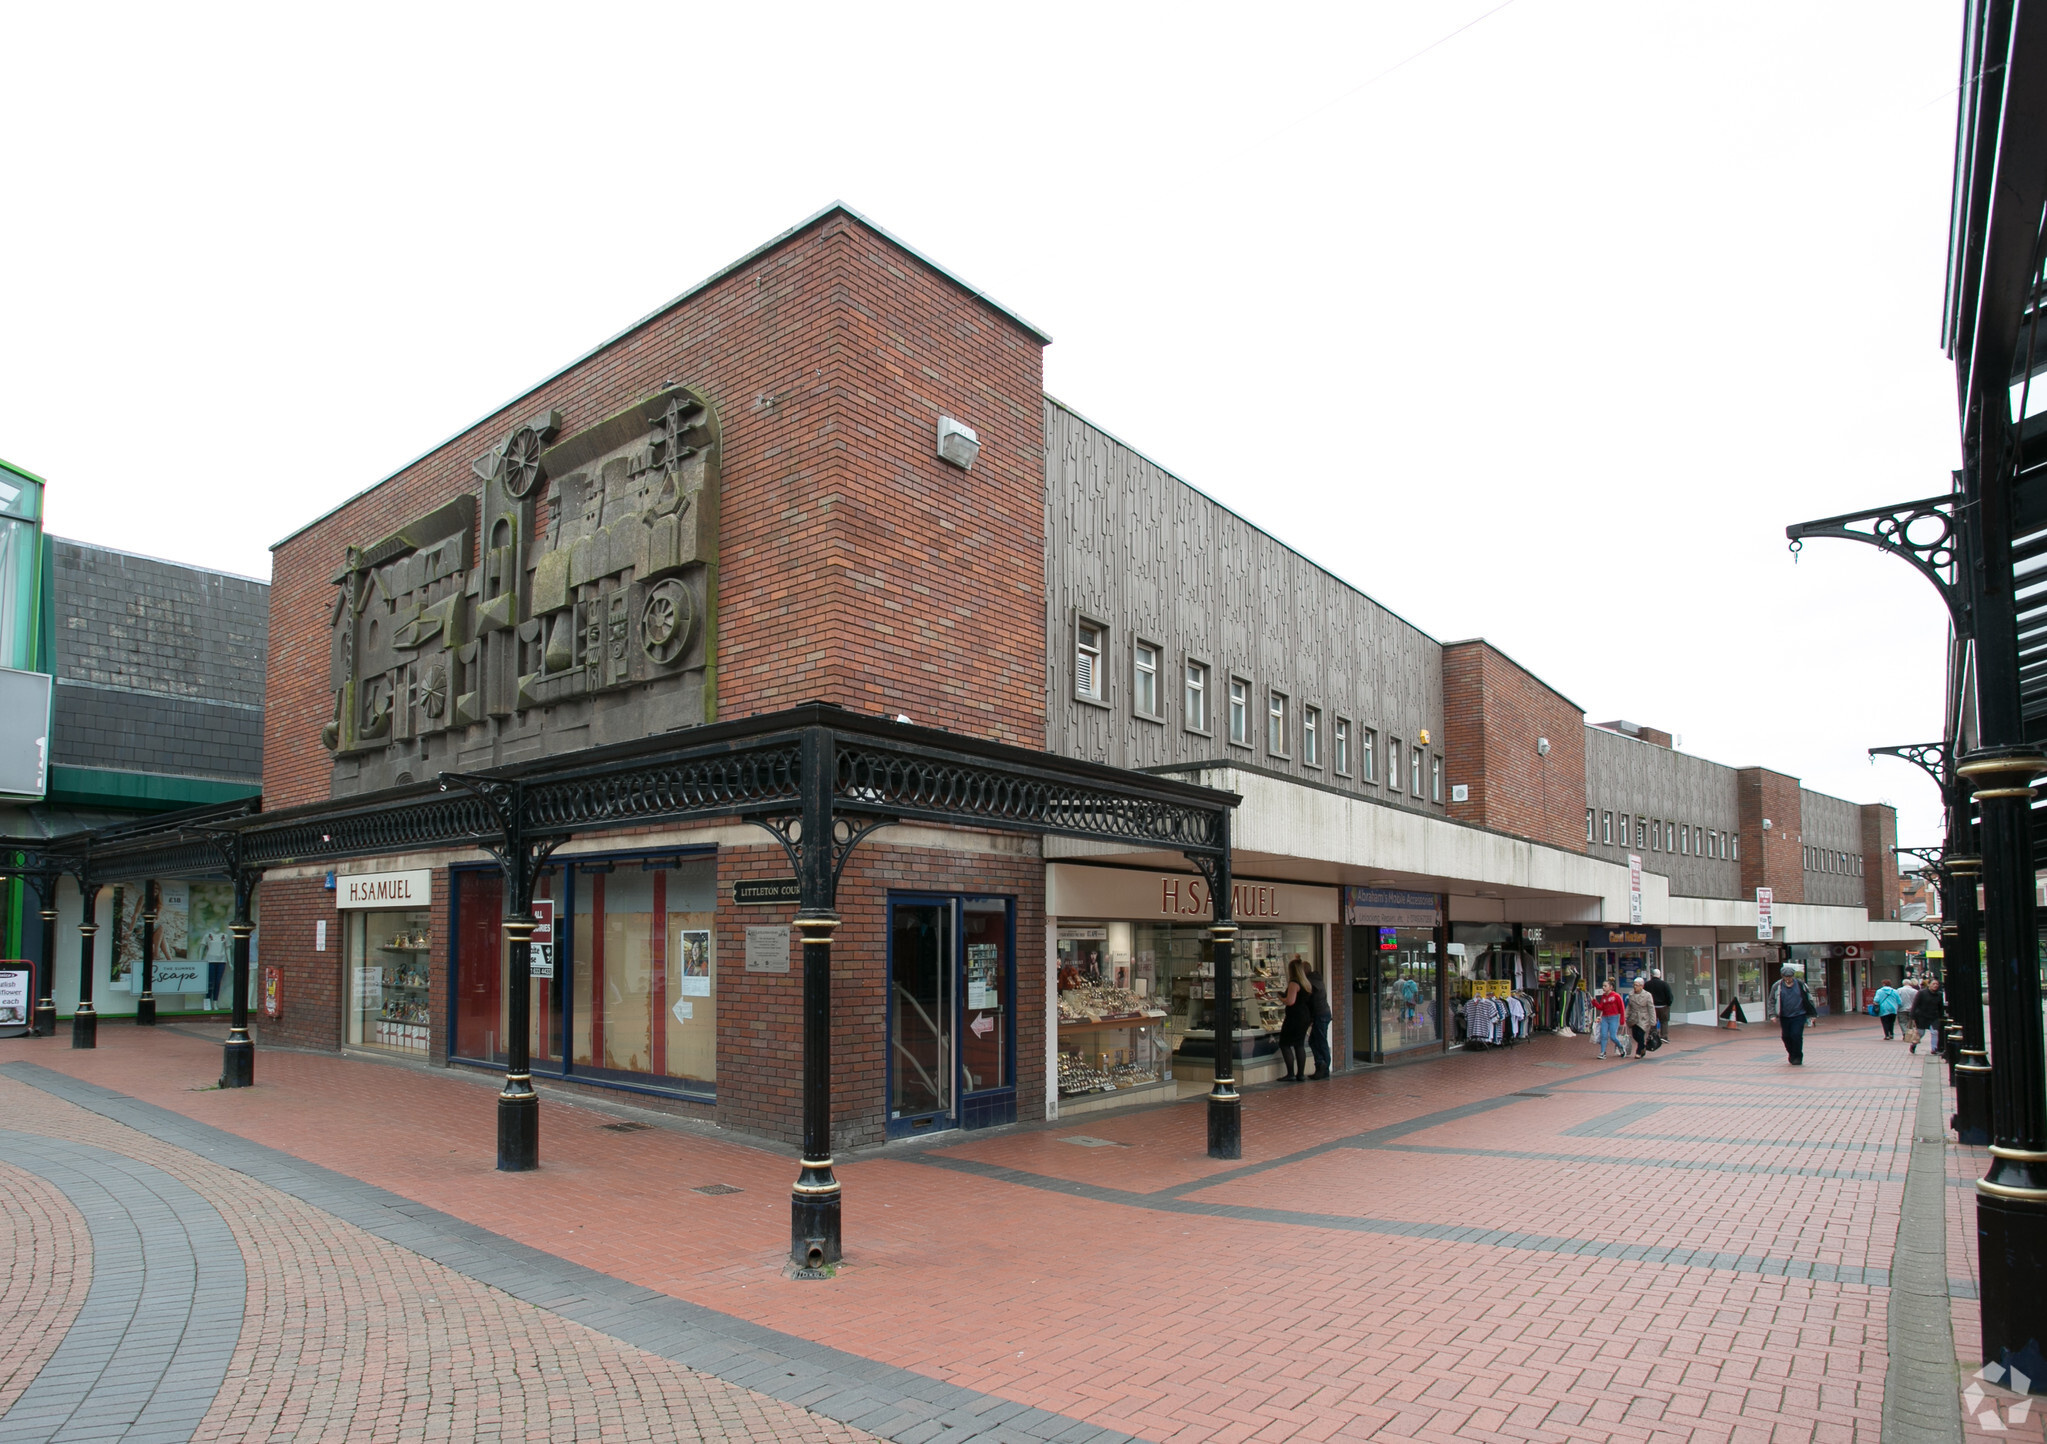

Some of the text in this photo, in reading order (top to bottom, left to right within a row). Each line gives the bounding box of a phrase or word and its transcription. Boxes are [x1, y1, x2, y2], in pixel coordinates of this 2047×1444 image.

[349, 879, 411, 901] H.SAMUEL
[741, 886, 800, 896] LITTLETON COUR
[1160, 877, 1280, 918] H.SAUEL
[1357, 889, 1388, 903] Abraham's
[534, 910, 543, 919] ALL
[533, 924, 551, 932] IRIES
[1528, 928, 1542, 941] CUBE
[530, 945, 540, 954] ite
